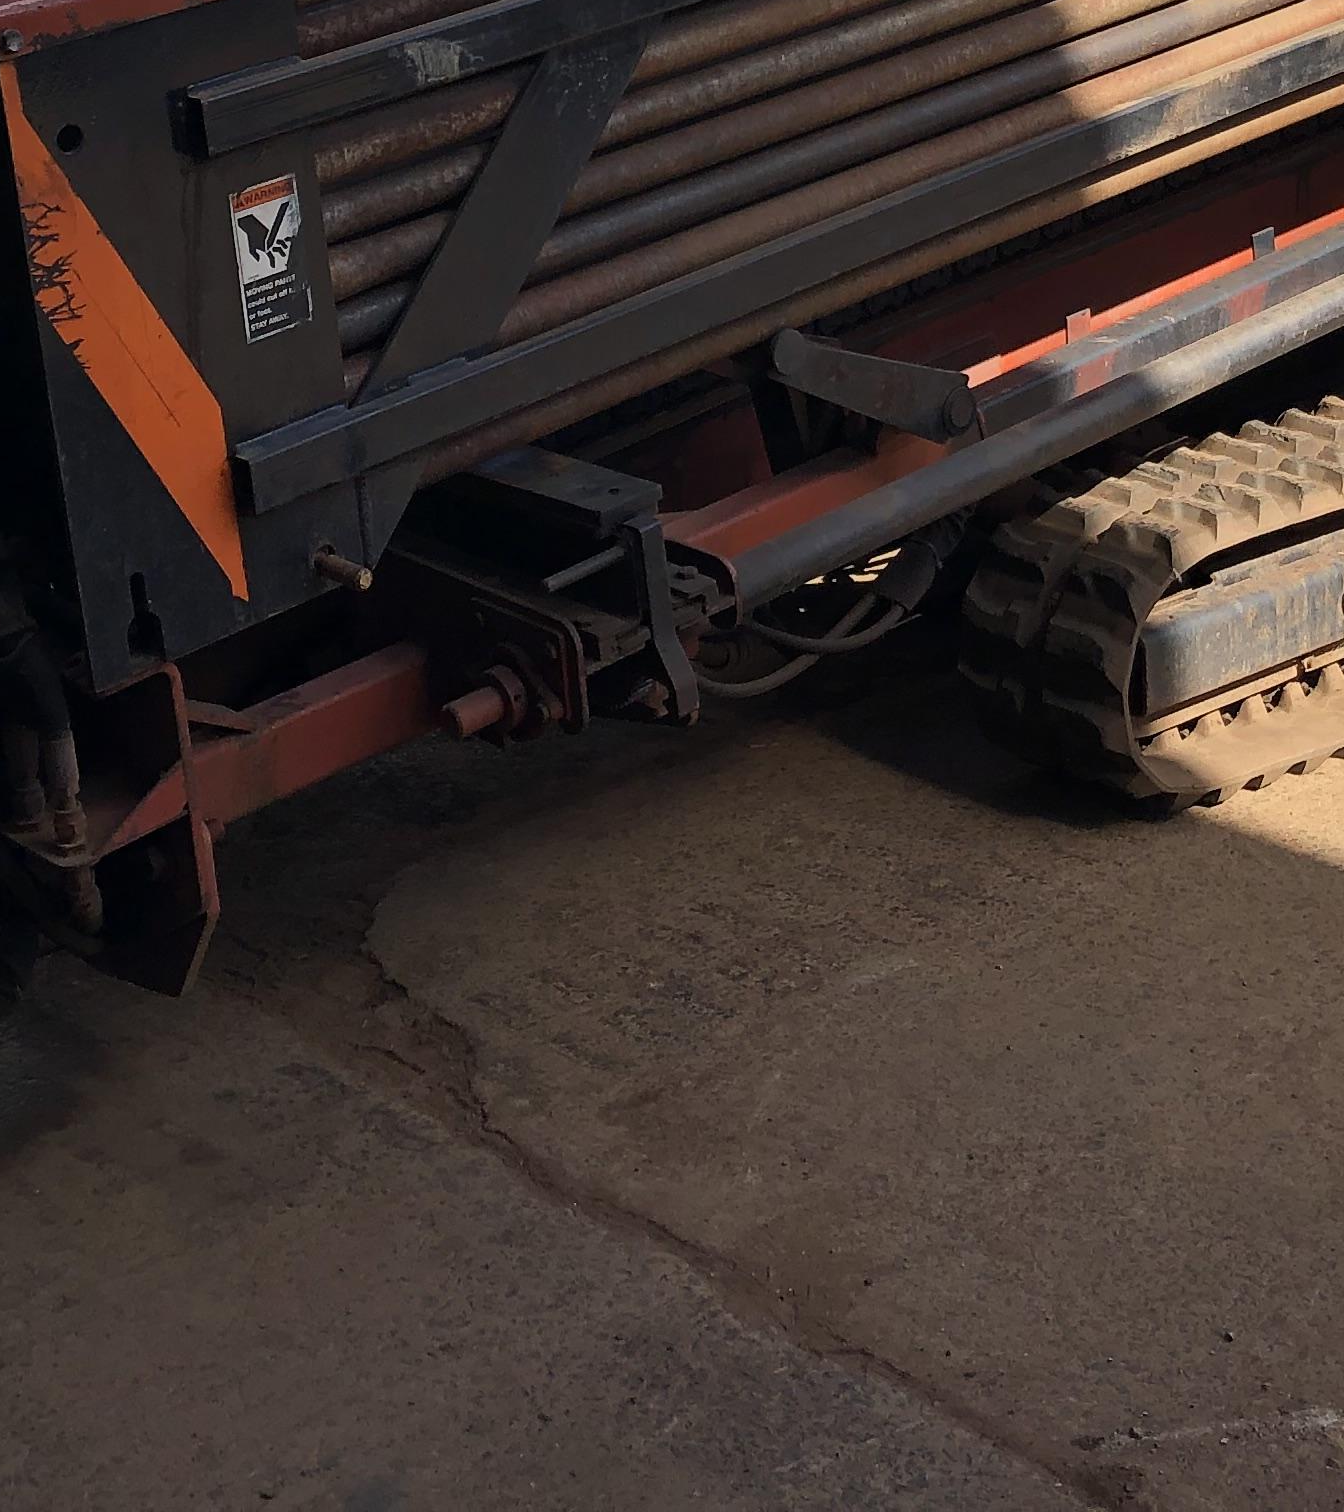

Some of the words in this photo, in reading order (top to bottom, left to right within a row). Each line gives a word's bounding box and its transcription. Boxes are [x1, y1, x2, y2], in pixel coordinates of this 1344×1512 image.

[244, 182, 292, 204] WARNING
[246, 282, 274, 296] MOVING
[250, 319, 268, 332] STAY
